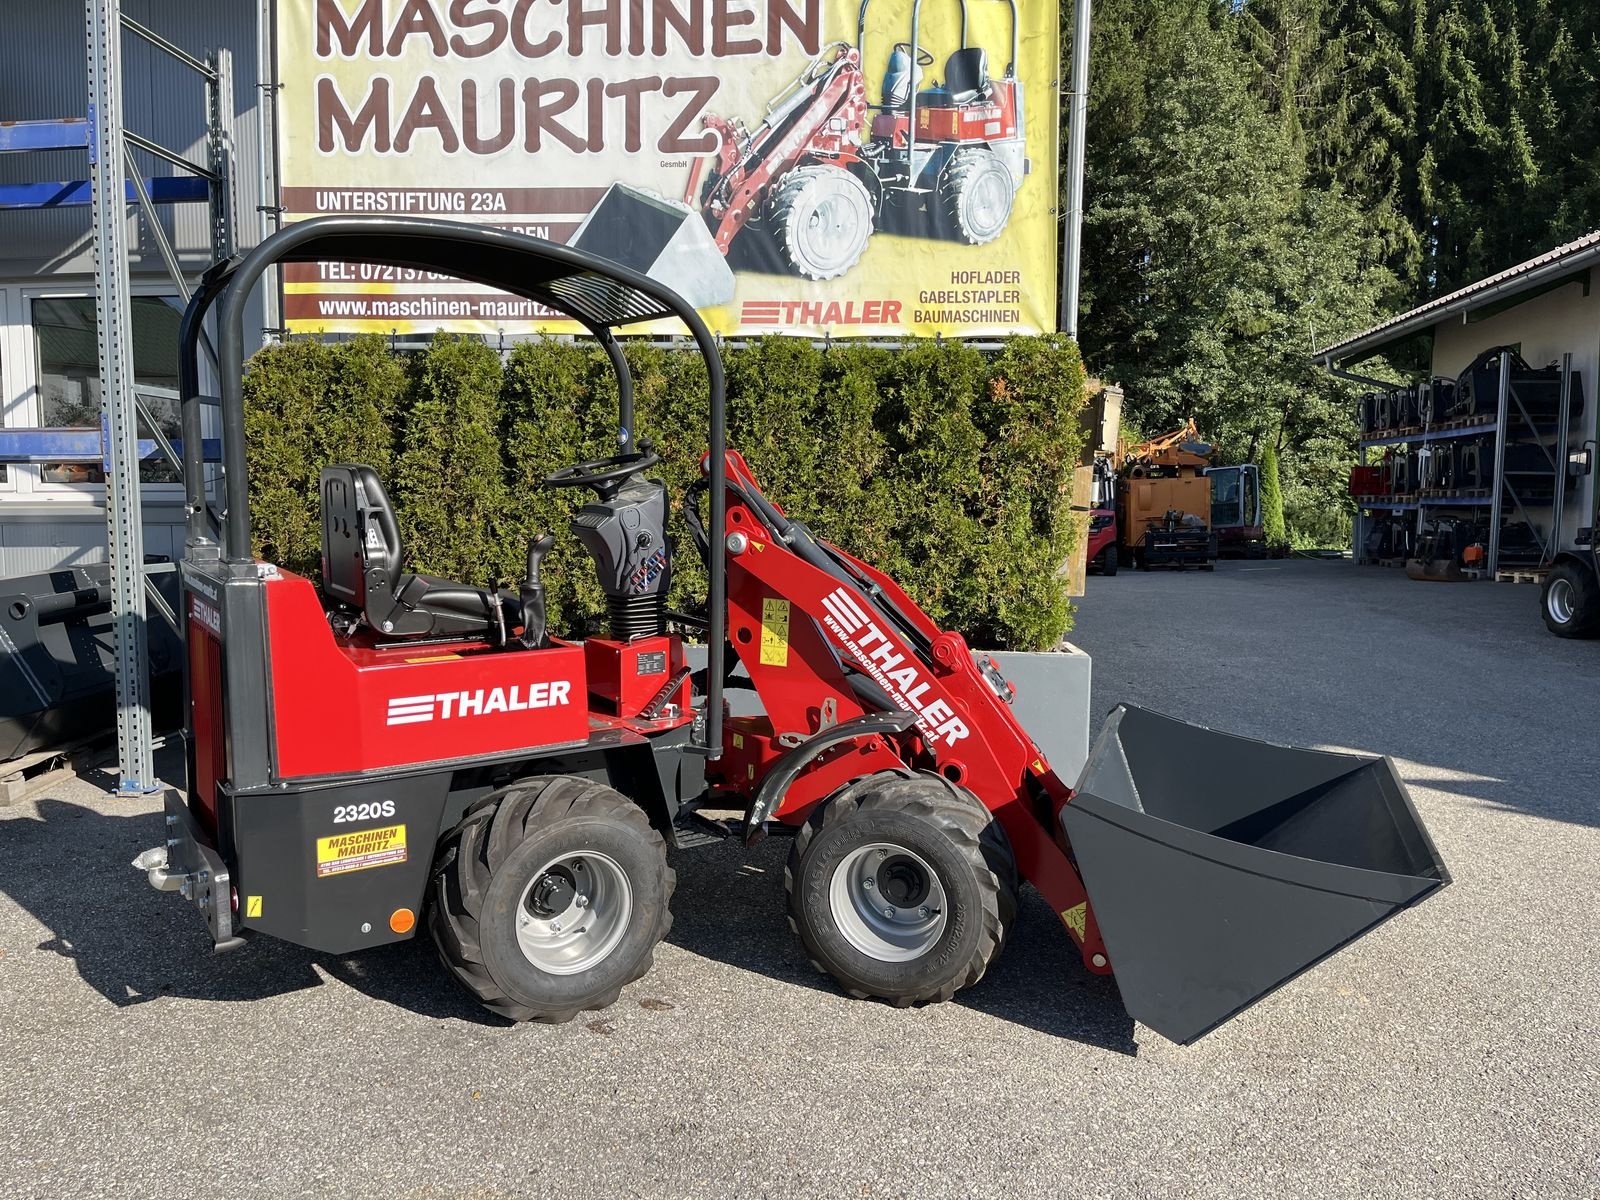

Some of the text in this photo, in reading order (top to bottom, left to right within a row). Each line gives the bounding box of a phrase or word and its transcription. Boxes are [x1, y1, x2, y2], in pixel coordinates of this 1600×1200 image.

[316, 0, 820, 57] MASCHINEN
[316, 76, 720, 154] MAURITZ
[315, 191, 507, 211] UNTERSTIFTUNG 23A
[317, 261, 356, 280] TEL:
[950, 271, 1020, 285] HOFLADER
[918, 290, 1020, 304] GABELSTAPLER
[913, 309, 1020, 323] BAUMASCHINEN
[333, 800, 396, 823] 2320S
[328, 828, 398, 849] MASCHINEN
[337, 840, 390, 858] MAURITZ
